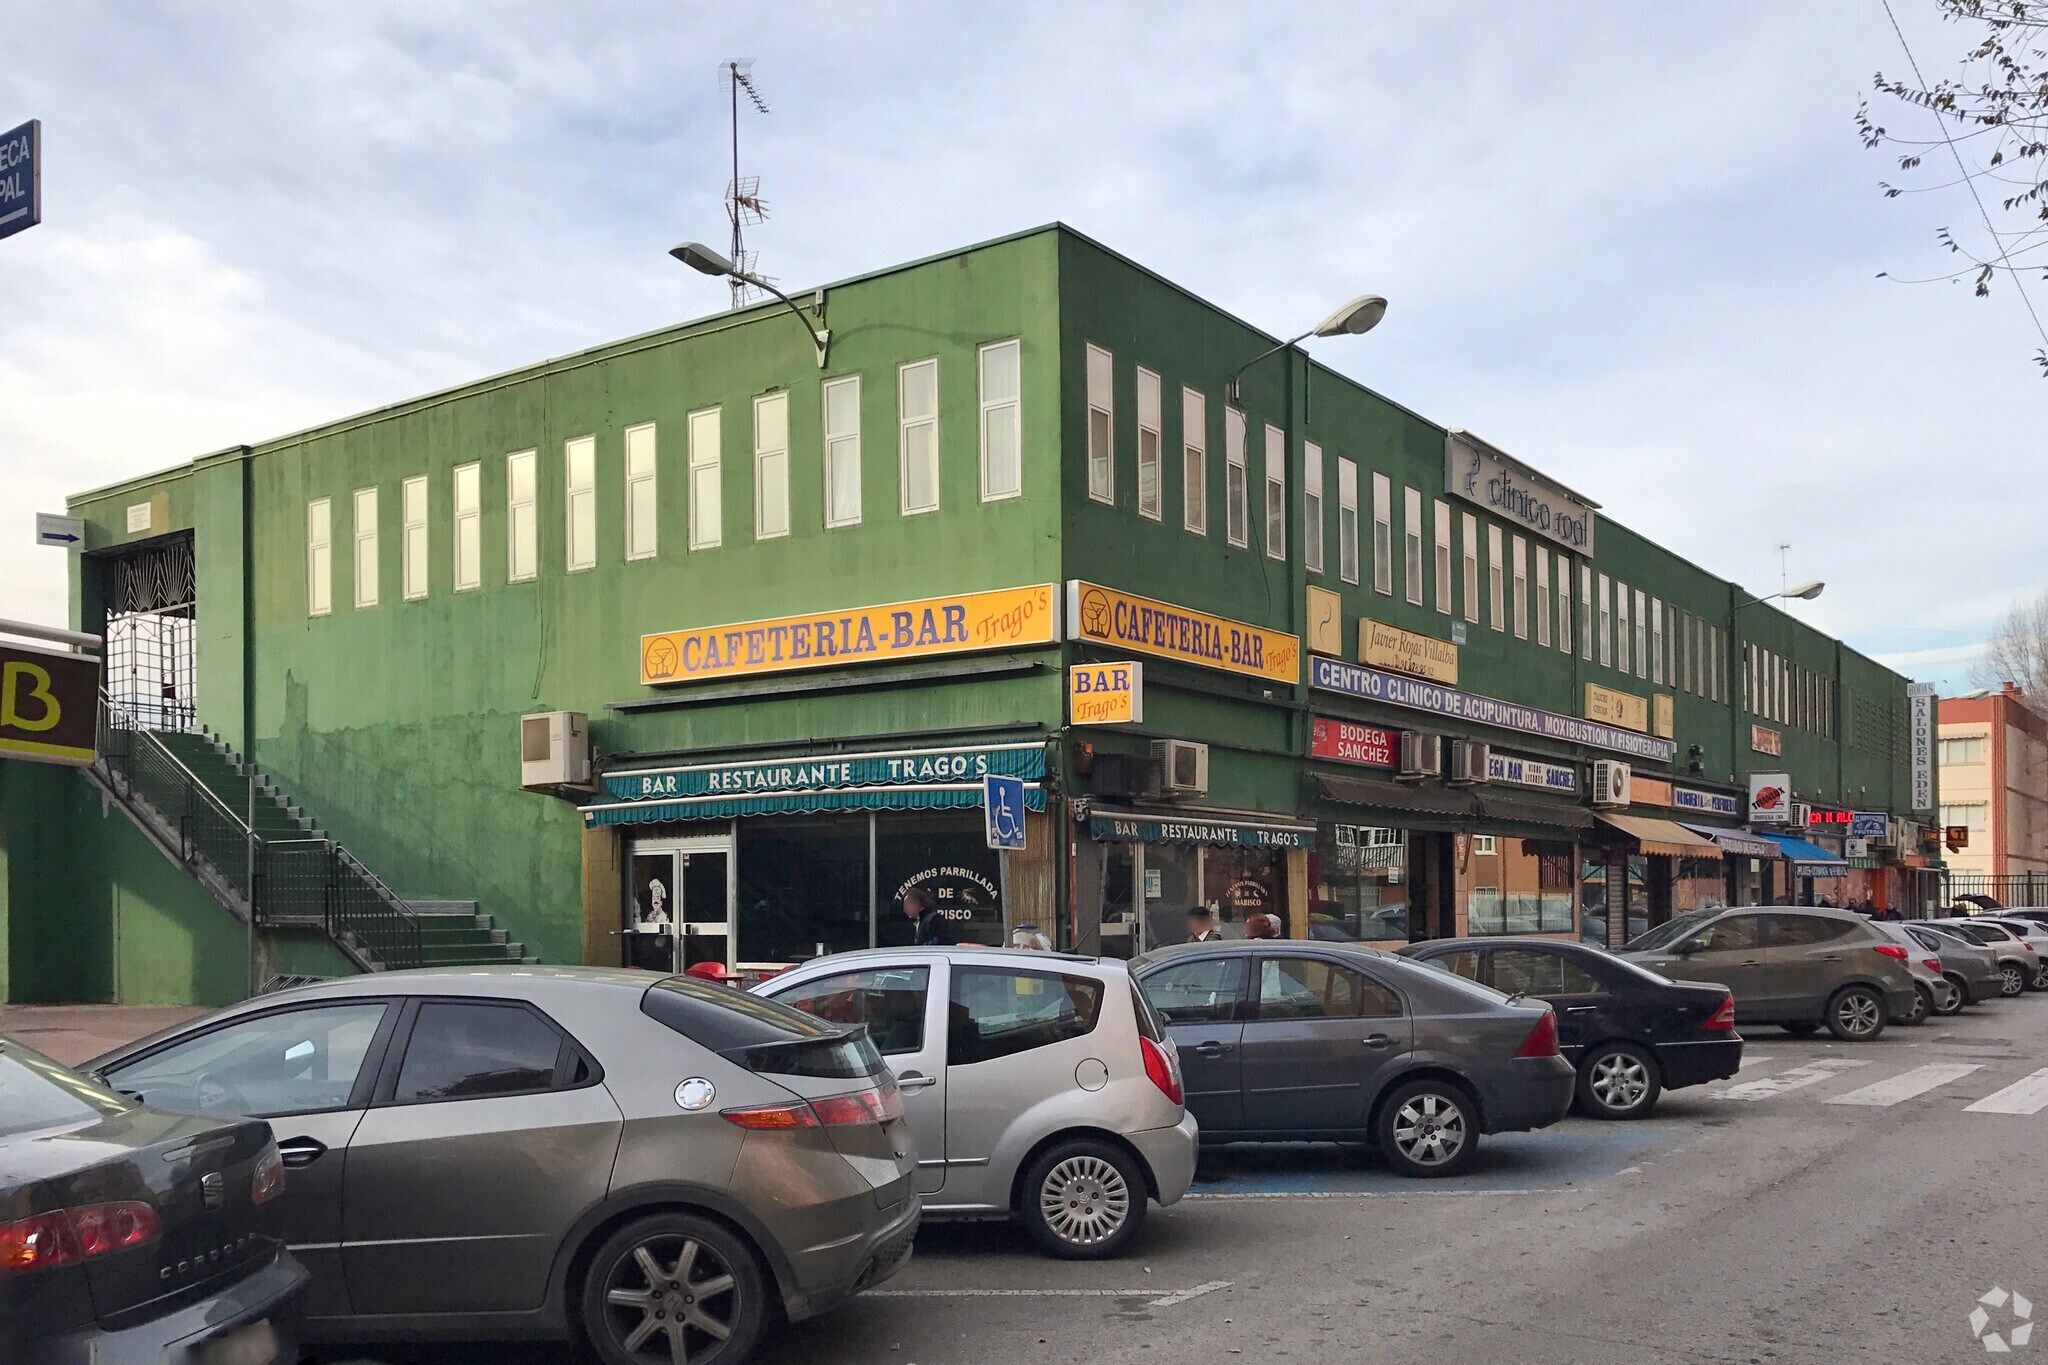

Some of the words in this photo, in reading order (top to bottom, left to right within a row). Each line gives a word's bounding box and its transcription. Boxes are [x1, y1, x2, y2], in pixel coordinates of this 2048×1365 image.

[682, 604, 969, 673] CAFETERIA-BAR
[976, 590, 1048, 643] Trago's
[1114, 600, 1264, 670] CAFETERIA-BAR
[1265, 641, 1297, 673] Trago's
[1369, 624, 1398, 650] Javier
[1399, 630, 1422, 661] Rojas
[1424, 638, 1455, 666] Villalba
[1074, 669, 1130, 693] BAR
[1077, 693, 1128, 721] Trago's
[1319, 662, 1381, 695] CENTRO
[1387, 679, 1441, 708] CLINICO
[1445, 694, 1461, 714] DE
[1544, 715, 1607, 744] MOXIBUSTION
[1610, 732, 1617, 748] Y
[1618, 733, 1669, 760] FISIOTERAPIA
[1340, 724, 1388, 746] BODEGA
[1915, 698, 1928, 766] SALONES
[1338, 741, 1390, 764] SANCHEZ
[642, 775, 678, 795] BAR
[709, 762, 851, 789] RESTAURANTE
[1488, 758, 1505, 778] EGA
[1507, 760, 1523, 781] BAR
[1916, 770, 1928, 808] EDEN
[1114, 821, 1139, 837] BAR
[1161, 823, 1238, 842] RESTAURANTE
[894, 868, 938, 901] TENEMOS
[940, 866, 999, 900] PARRILLADA
[938, 887, 954, 899] DE
[937, 909, 972, 920] ISCO
[1234, 898, 1262, 907] MARISCO
